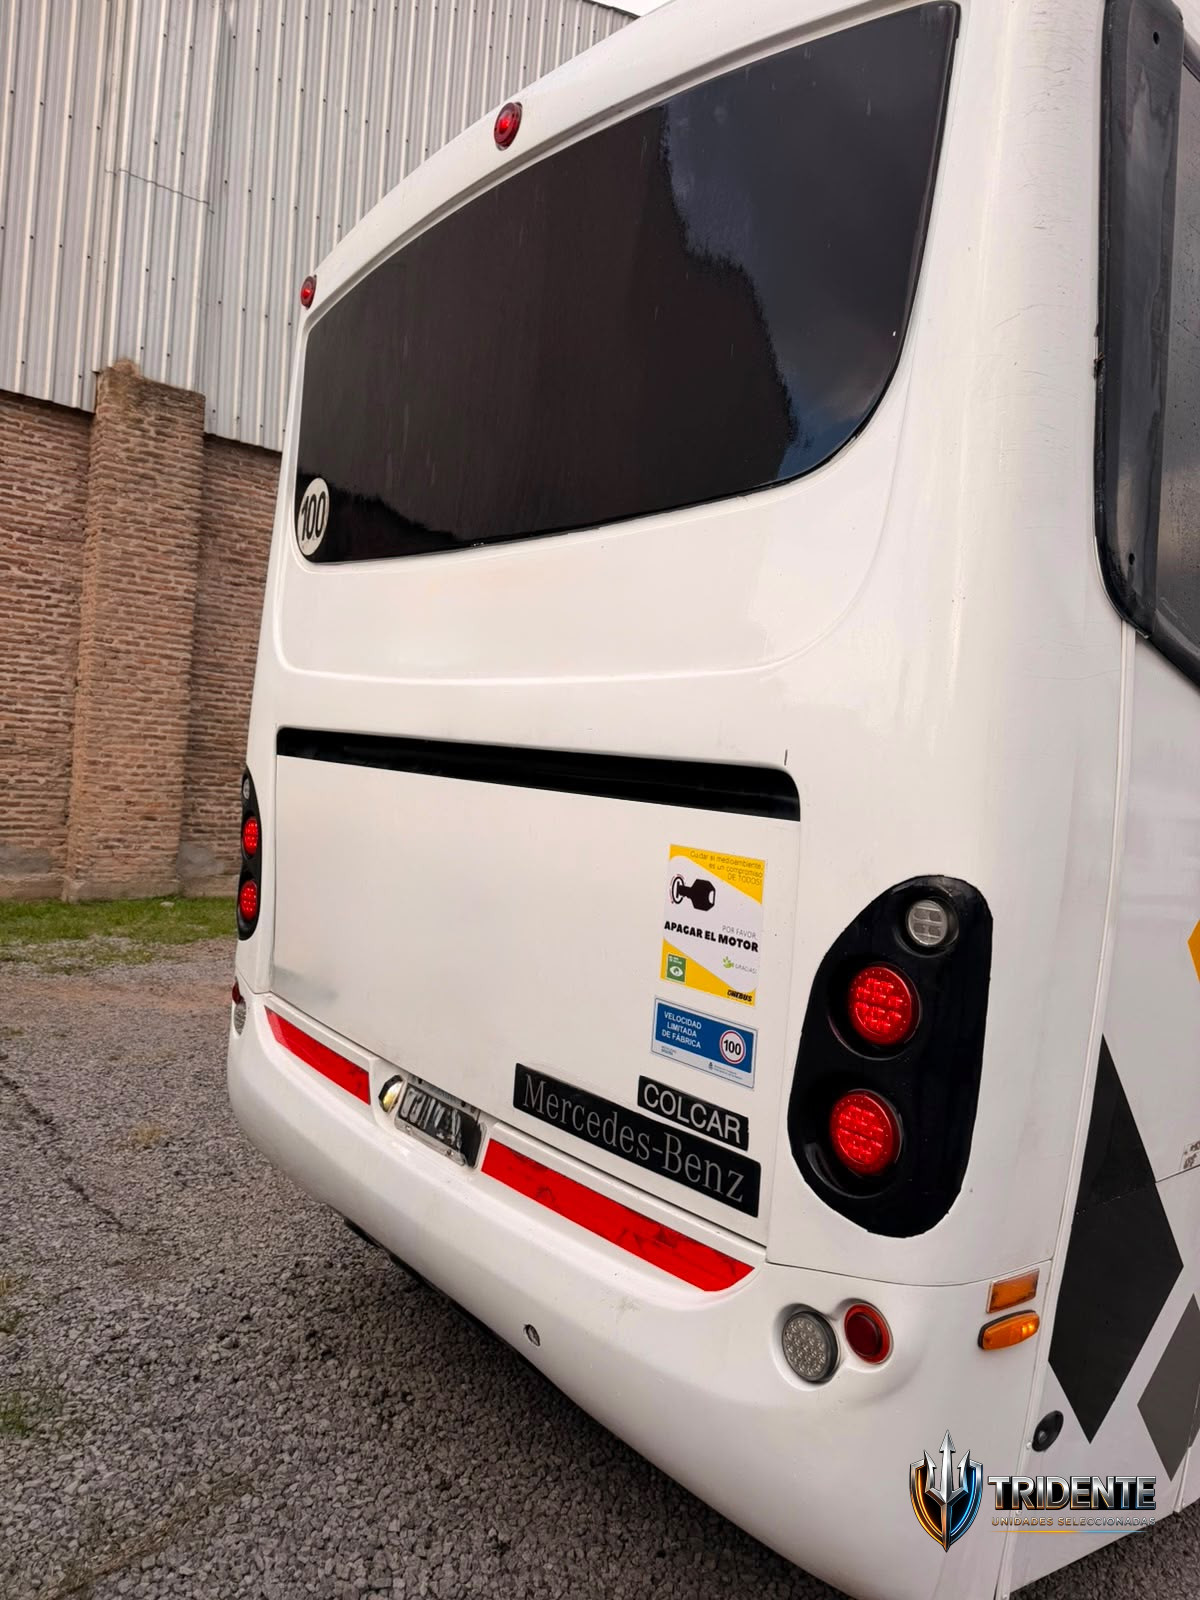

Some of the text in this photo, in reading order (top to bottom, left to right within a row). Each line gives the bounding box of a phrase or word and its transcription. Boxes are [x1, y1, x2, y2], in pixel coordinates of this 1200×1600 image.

[301, 490, 326, 542] 100
[727, 872, 736, 881] DE
[664, 920, 759, 953] APAGAR EL MOTOR
[722, 924, 735, 934] POR
[664, 1010, 702, 1030] VELOCIDAD
[667, 1021, 697, 1038] LIMITADA
[661, 1029, 702, 1049] DE FÁBRICA
[723, 1039, 742, 1056] 100
[643, 1083, 741, 1144] COLCAR
[522, 1074, 745, 1204] Mercedes-Benz
